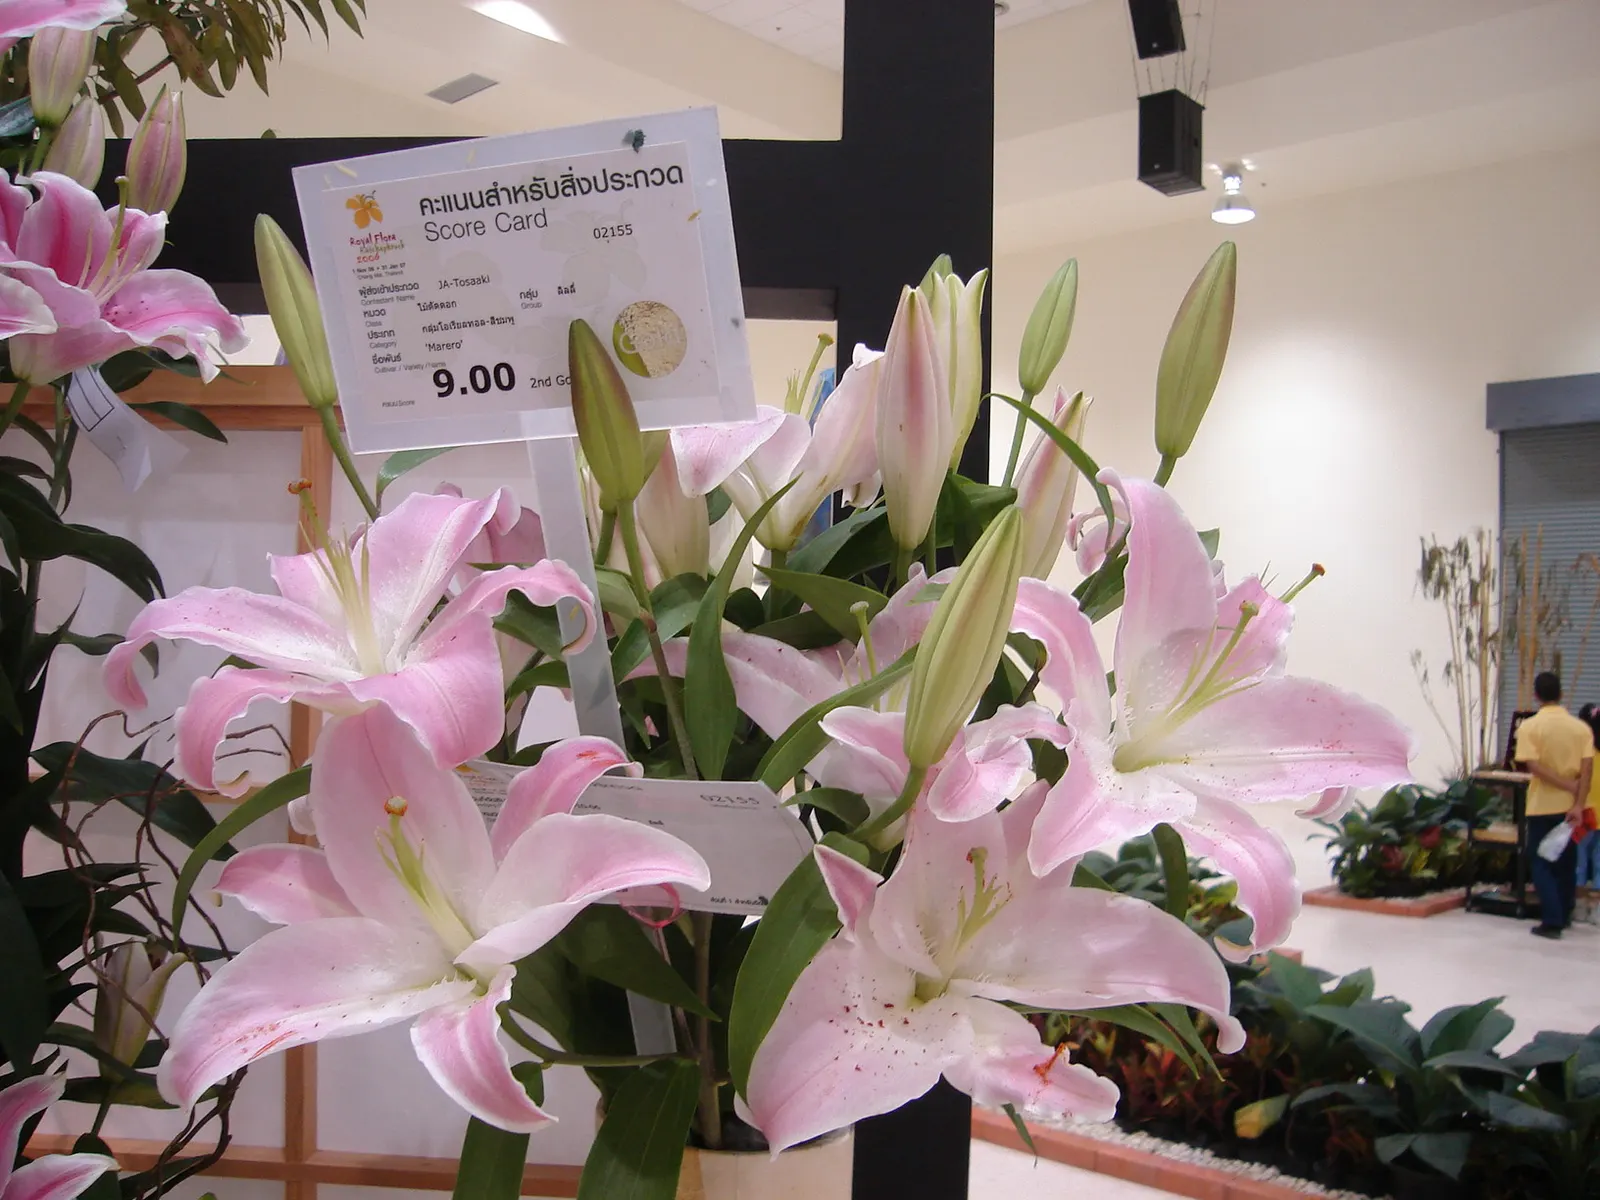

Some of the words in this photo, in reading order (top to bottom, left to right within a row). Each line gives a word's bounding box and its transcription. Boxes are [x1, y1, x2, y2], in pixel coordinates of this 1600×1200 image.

[419, 165, 684, 216] คะแนนสำหรับสิ่งประกวด
[424, 219, 486, 242] Score
[495, 208, 548, 233] Card
[593, 223, 633, 239] 02155
[350, 233, 372, 248] Royal
[374, 232, 397, 244] Flora
[356, 252, 380, 264] 2006
[438, 274, 490, 290] JA-Tosaaki
[519, 288, 539, 301] กลุ่ม
[521, 302, 542, 310] Group
[367, 329, 395, 340] ประเภท
[432, 362, 516, 398] 9.00
[530, 376, 552, 389] 2nd
[556, 374, 572, 387] Go
